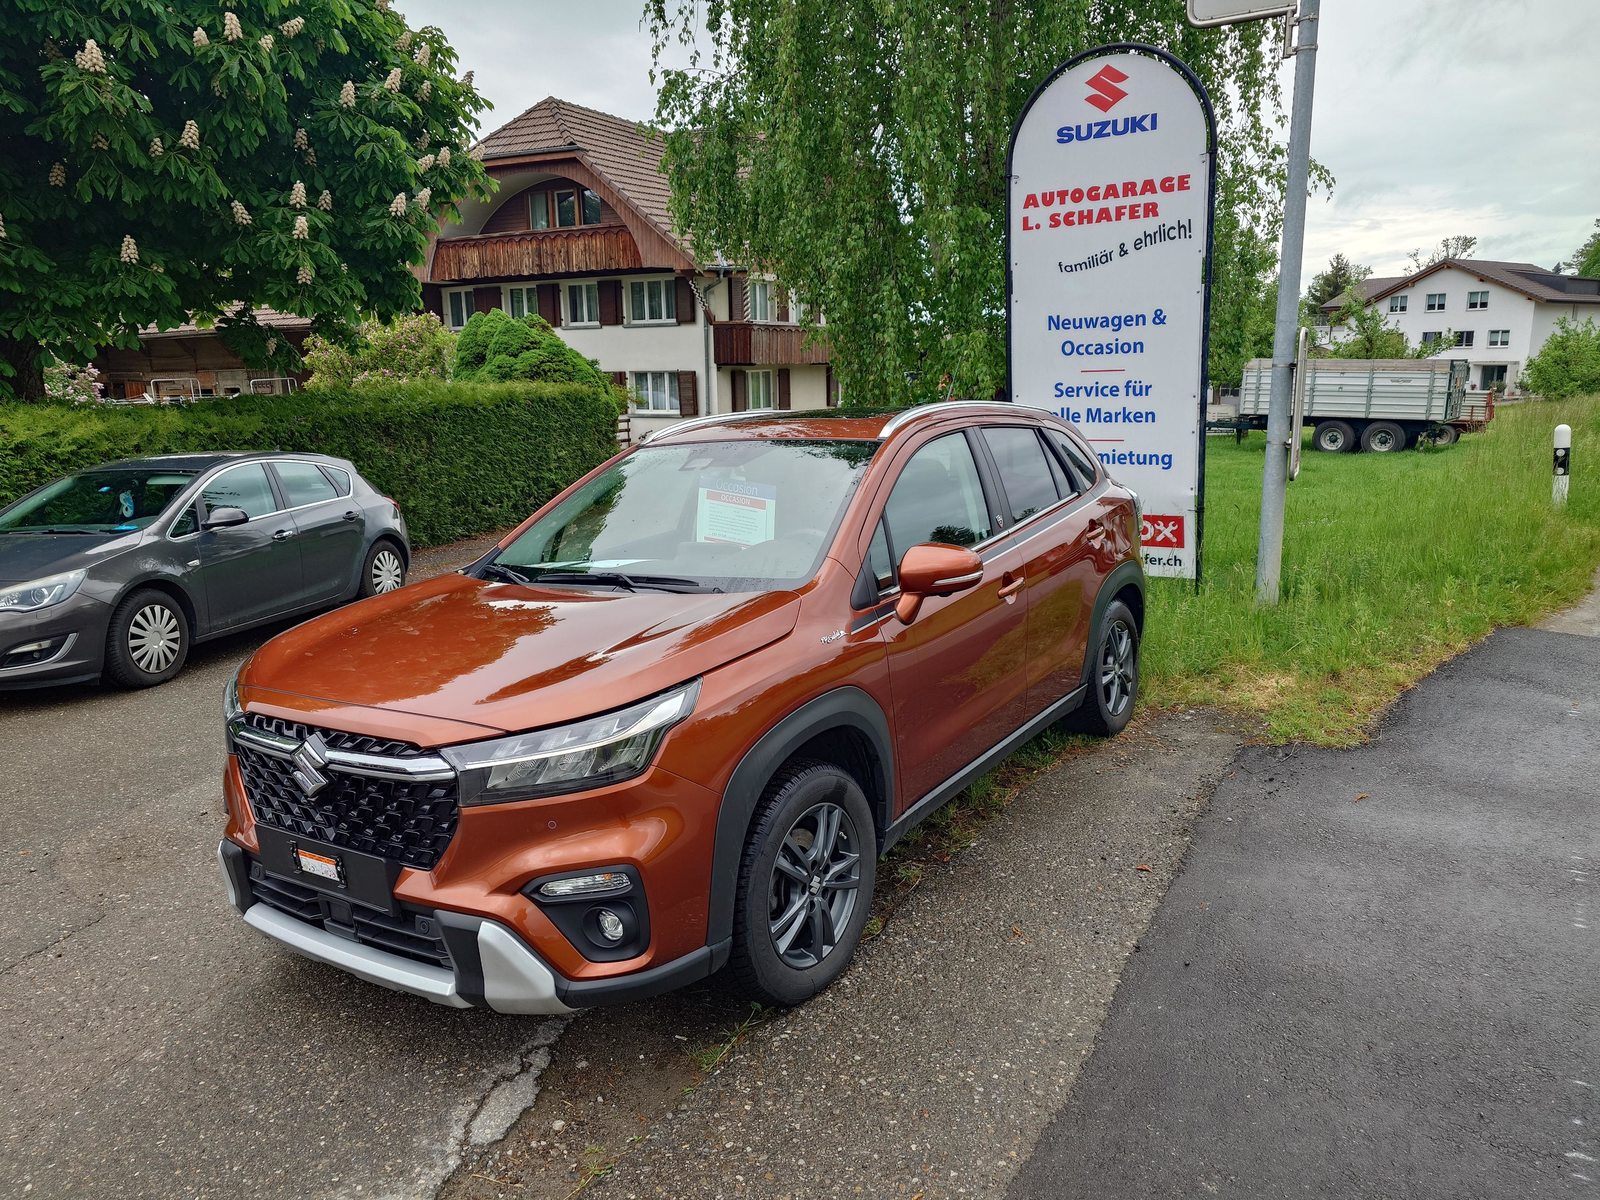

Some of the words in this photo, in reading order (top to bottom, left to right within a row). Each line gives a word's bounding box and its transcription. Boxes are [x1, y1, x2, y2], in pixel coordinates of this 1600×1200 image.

[1056, 113, 1158, 144] SUZUKI
[1022, 174, 1191, 209] AUTOGARAGE
[1022, 216, 1041, 231] L.
[1048, 202, 1159, 229] SCHAFER
[1058, 250, 1114, 273] familiär
[1118, 242, 1129, 258] &
[1133, 218, 1192, 251] ehrlich!
[1047, 312, 1148, 332] Neuwagen
[1151, 307, 1168, 326] &
[1060, 337, 1145, 357] Occasion
[1053, 381, 1120, 398] Service
[1124, 380, 1153, 397] für
[1085, 406, 1157, 424] Marken
[1097, 448, 1174, 471] mietung
[716, 480, 758, 496] Occasion
[720, 494, 751, 505] OCCASION
